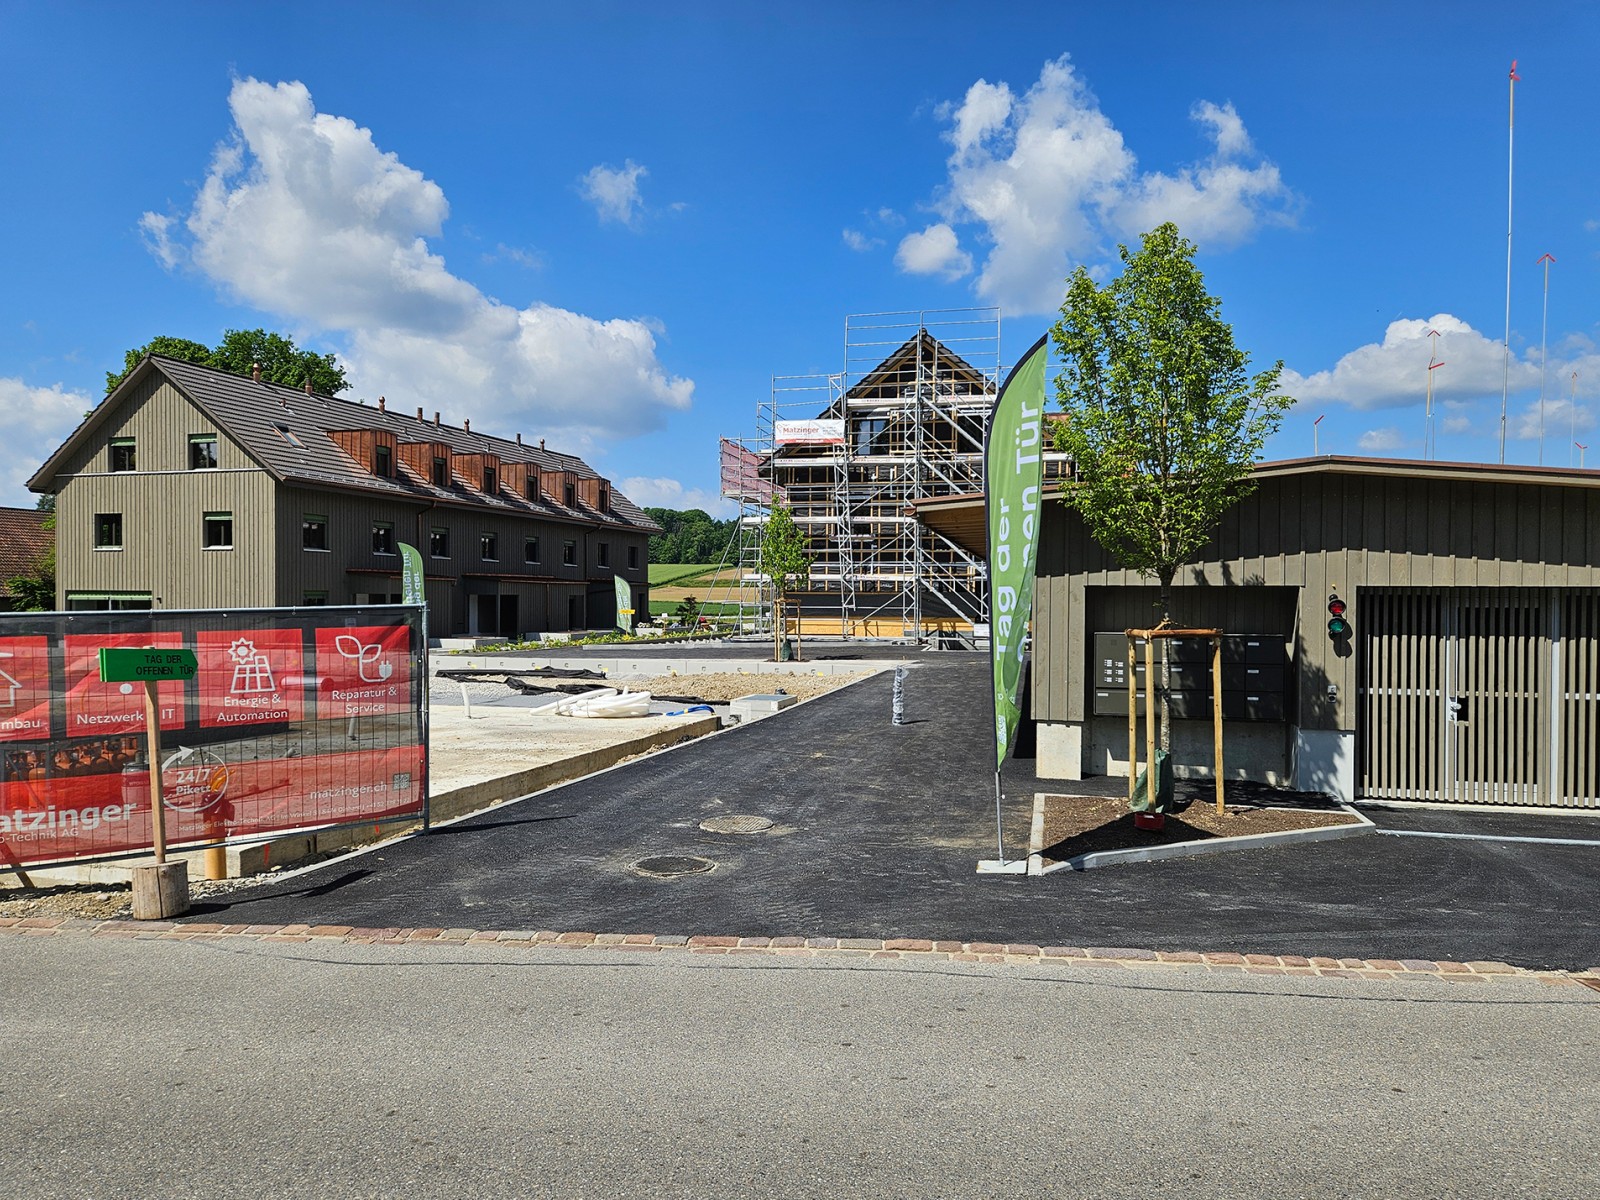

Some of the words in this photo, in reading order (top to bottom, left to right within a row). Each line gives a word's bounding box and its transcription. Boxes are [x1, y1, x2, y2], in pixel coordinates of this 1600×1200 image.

[1016, 401, 1040, 475] Tür
[997, 498, 1010, 573] der
[996, 585, 1017, 661] Tag
[145, 655, 162, 663] TAG
[166, 655, 182, 663] DER
[136, 667, 173, 675] OFFENEN
[180, 664, 194, 675] TÜR
[224, 695, 269, 708] Energie
[271, 693, 281, 703] &
[332, 689, 385, 701] Reparatur
[388, 686, 397, 696] &
[216, 709, 289, 722] Automation
[345, 702, 385, 714] Service
[0, 718, 40, 730] mbau
[76, 711, 144, 725] Netzwerk
[161, 708, 175, 720] IT
[176, 768, 211, 784] 24/7
[175, 784, 211, 796] Pikett
[310, 780, 388, 799] matzinger.ch
[0, 802, 138, 834] atzinger
[179, 822, 212, 833] Matzinger
[0, 829, 57, 844] o-Technik
[62, 828, 79, 838] AG
